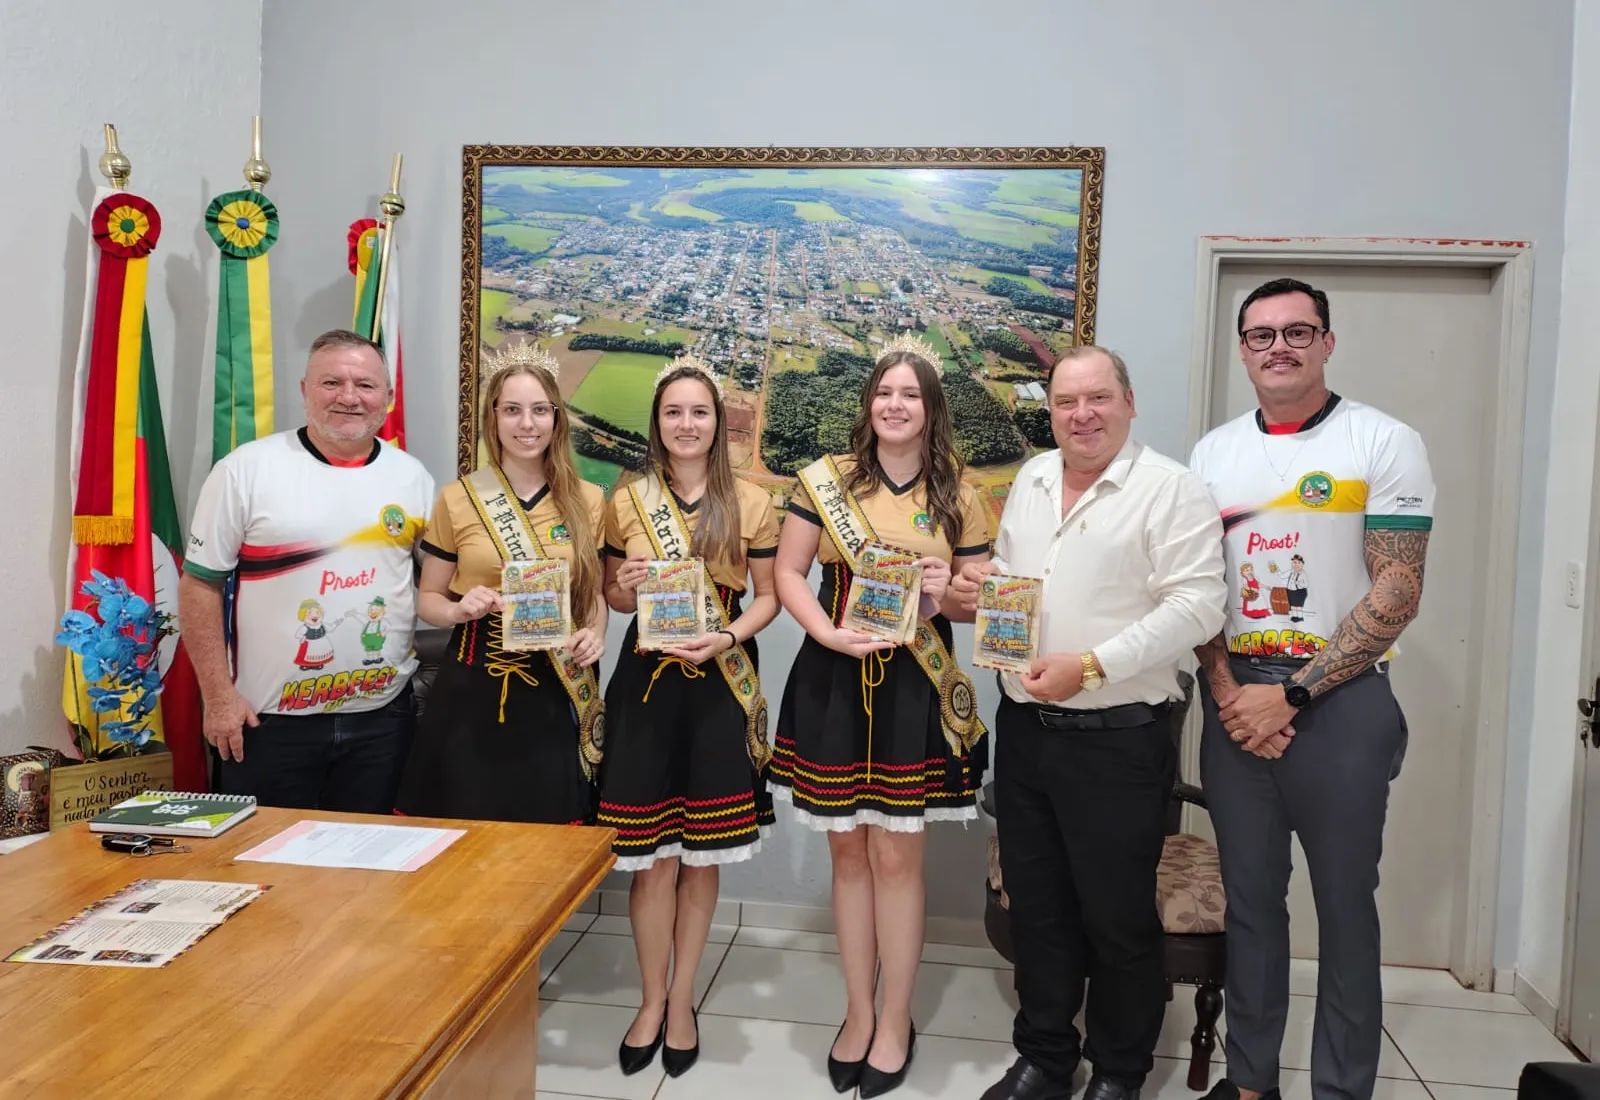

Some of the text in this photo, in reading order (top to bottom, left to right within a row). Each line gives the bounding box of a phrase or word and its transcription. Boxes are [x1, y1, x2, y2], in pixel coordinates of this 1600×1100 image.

[1246, 531, 1300, 556] Prost!
[319, 567, 376, 596] Prost!
[277, 665, 398, 712] KERBFEST
[84, 769, 151, 791] O Senhor
[63, 796, 70, 810] é
[76, 794, 105, 809] meu
[64, 806, 95, 823] nada
